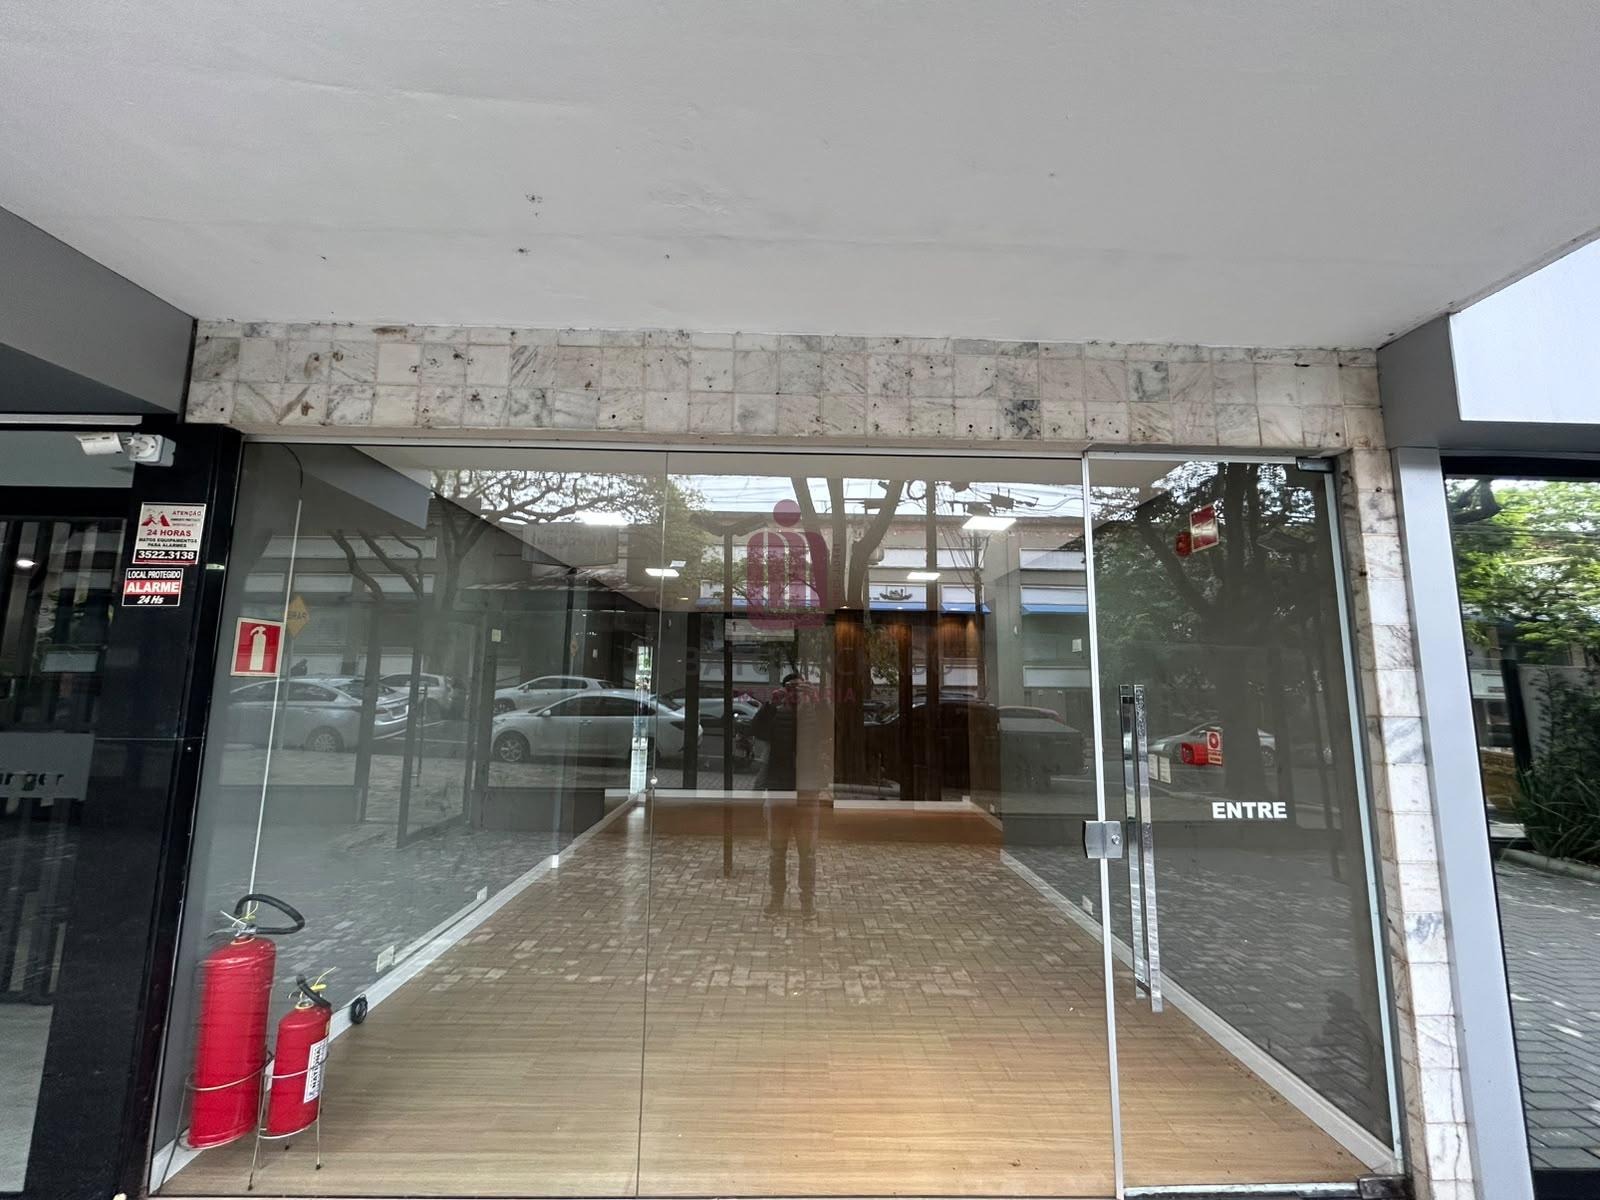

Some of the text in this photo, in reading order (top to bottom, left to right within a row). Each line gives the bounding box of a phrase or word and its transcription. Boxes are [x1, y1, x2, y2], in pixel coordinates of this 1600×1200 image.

[138, 550, 195, 560] 3522.3138
[128, 570, 181, 579] LOCAL PROTEGIDO
[126, 581, 180, 593] ALARME
[137, 595, 164, 604] 24 Hs
[1211, 801, 1288, 819] ENTRE
